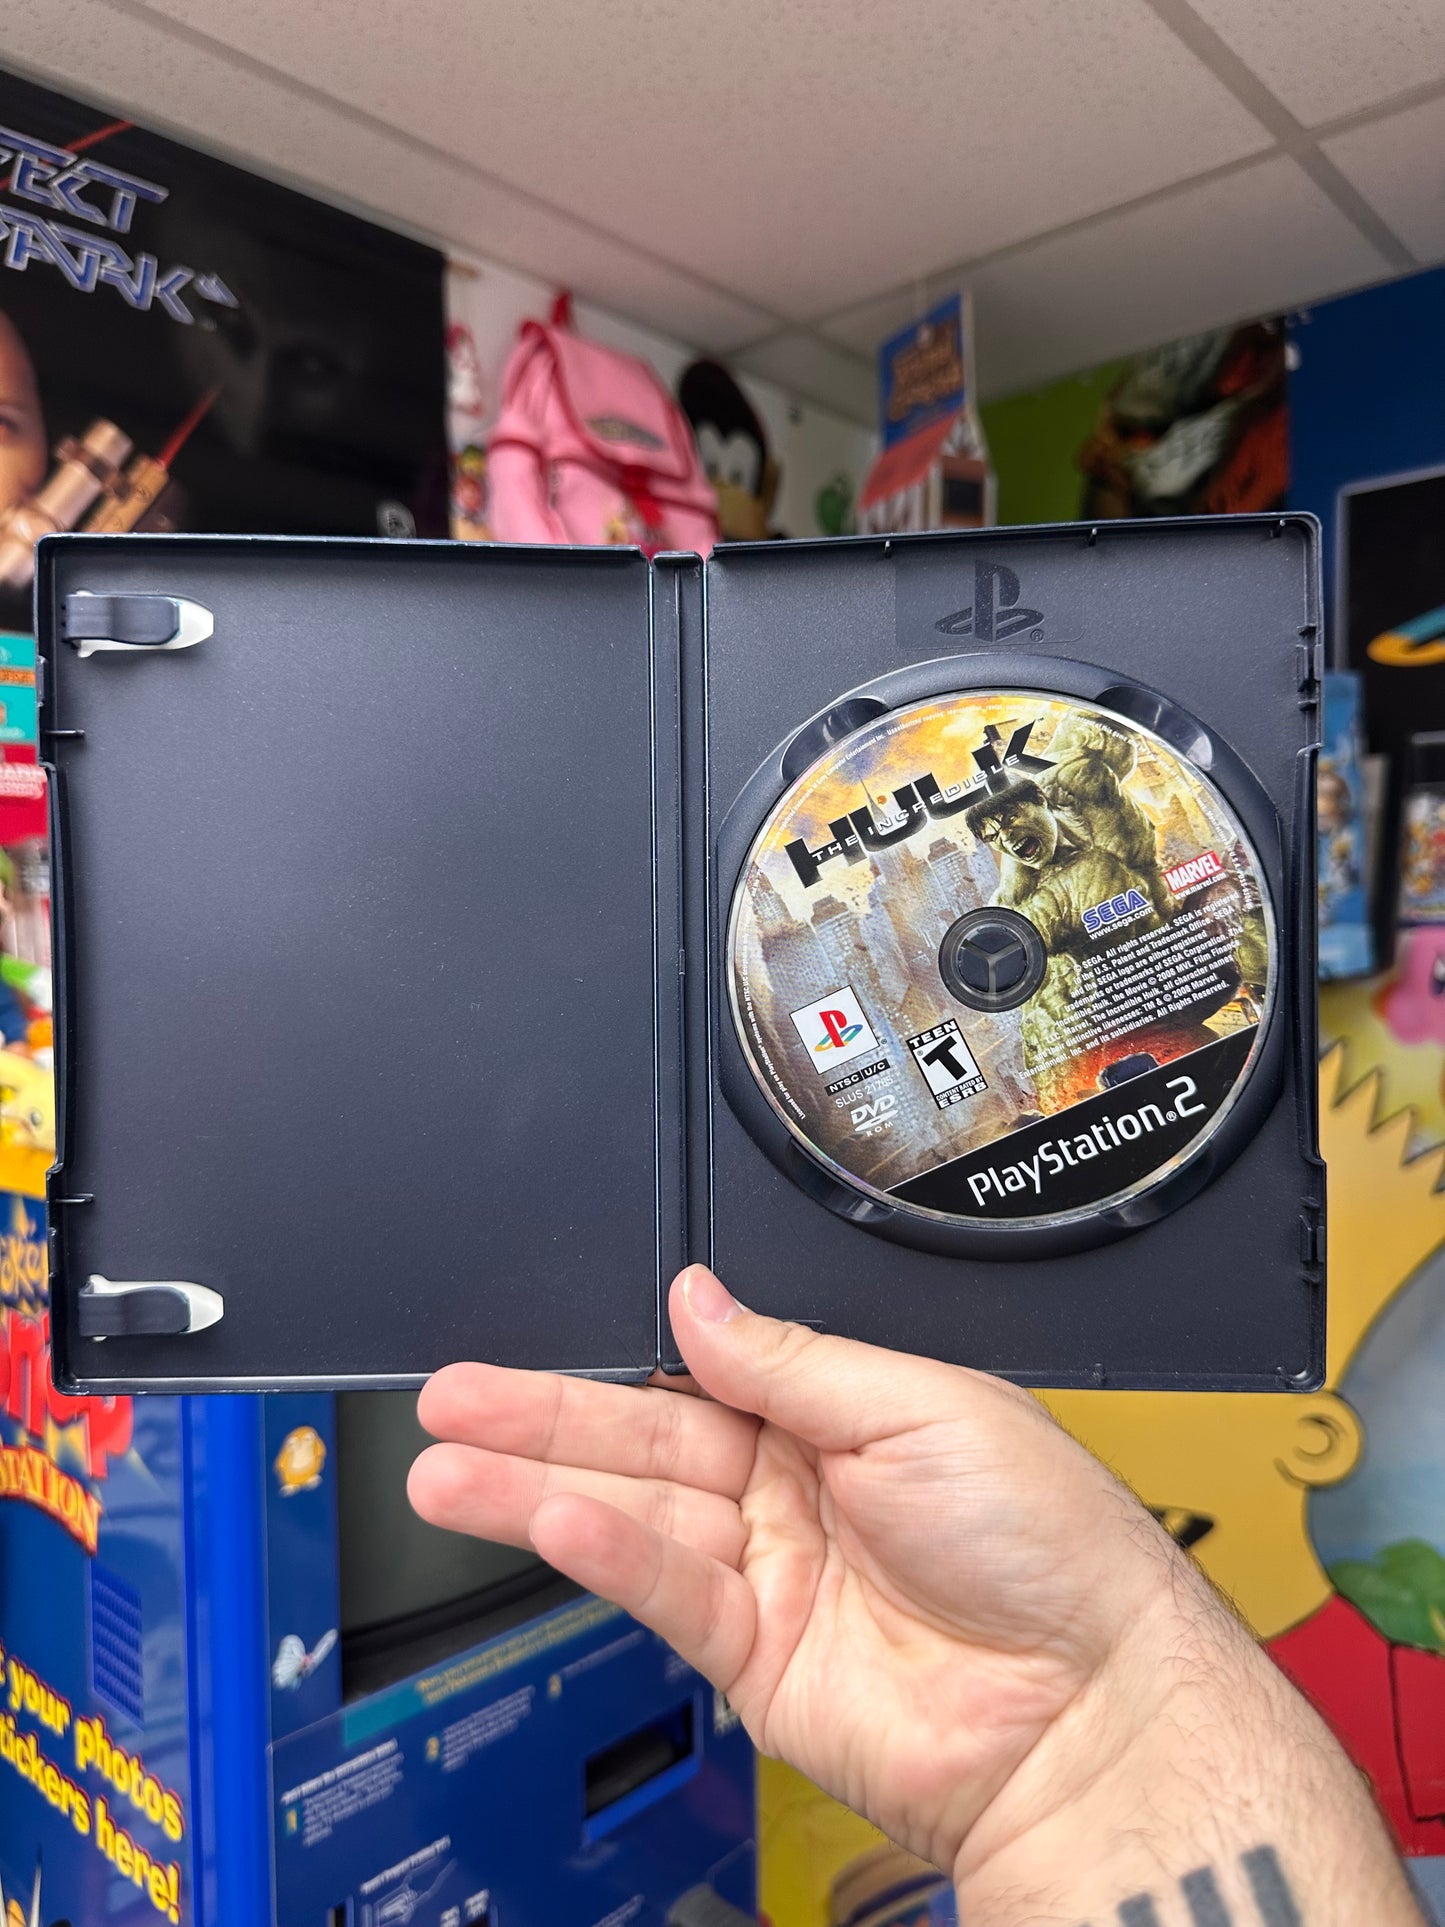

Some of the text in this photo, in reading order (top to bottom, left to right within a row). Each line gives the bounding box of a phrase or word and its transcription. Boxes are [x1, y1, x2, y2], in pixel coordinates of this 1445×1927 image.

[812, 834, 859, 861] THE
[867, 754, 1020, 836] INCREDIBLE
[1165, 853, 1222, 892] MARVEL
[1174, 872, 1227, 900] www.marvel.com
[1081, 952, 1105, 969] SEGA.
[1104, 947, 1117, 958] All
[1116, 937, 1139, 954] rights
[1137, 921, 1173, 943] reserved.
[1173, 912, 1194, 927] SEGA
[1202, 891, 1240, 915] registered
[1082, 888, 1150, 933] SEGA
[1089, 907, 1154, 940] www.sega.com
[1063, 988, 1104, 1012] trademarks
[1113, 965, 1154, 989] trademarks
[1162, 952, 1184, 967] SEGA
[1183, 932, 1229, 959] Corporation.
[1227, 925, 1244, 937] The
[1069, 929, 1208, 998] and the SEGA logo are either registered
[1081, 969, 1094, 980] the
[1093, 961, 1111, 975] U.S.
[1110, 950, 1136, 967] Patent
[1135, 944, 1150, 956] and
[1149, 926, 1189, 949] Trademark
[1188, 915, 1213, 932] Office.
[1213, 905, 1235, 920] SEGA
[1111, 991, 1125, 1002] the
[1124, 980, 1148, 996] Movie
[1156, 967, 1176, 982] 2008
[1175, 959, 1194, 973] MVL
[1193, 951, 1211, 965] Film
[1210, 938, 1240, 957] Finance
[1047, 1041, 1065, 1055] their
[1064, 1024, 1102, 1047] distinctive
[1171, 984, 1191, 998] 2008
[1190, 972, 1217, 989] Marvel
[1091, 1011, 1106, 1023] The
[1105, 994, 1142, 1016] Incredible
[1162, 980, 1174, 991] all
[1173, 964, 1208, 986] character
[1208, 954, 1233, 970] names
[909, 1021, 958, 1048] TEEN
[1069, 1044, 1085, 1056] Inc.
[1084, 1037, 1100, 1050] and
[1099, 1033, 1110, 1043] its
[1109, 1012, 1156, 1038] subsidiaries.
[1155, 1006, 1168, 1017] All
[1167, 995, 1193, 1013] Rights
[1191, 978, 1229, 1001] Reserved.
[829, 1062, 886, 1093] NTSC U/C
[922, 1035, 967, 1081] T
[835, 1076, 894, 1108] SLUS 21765
[851, 1094, 896, 1124] DVD
[936, 1087, 960, 1101] CONTENT
[959, 1079, 976, 1093] RATED
[939, 1082, 987, 1108] ESRB
[866, 1121, 893, 1137] ROM
[0, 1444, 103, 1557] TATION
[9, 1655, 73, 1738] your
[75, 1714, 185, 1842] photos
[96, 1796, 181, 1926] here!
